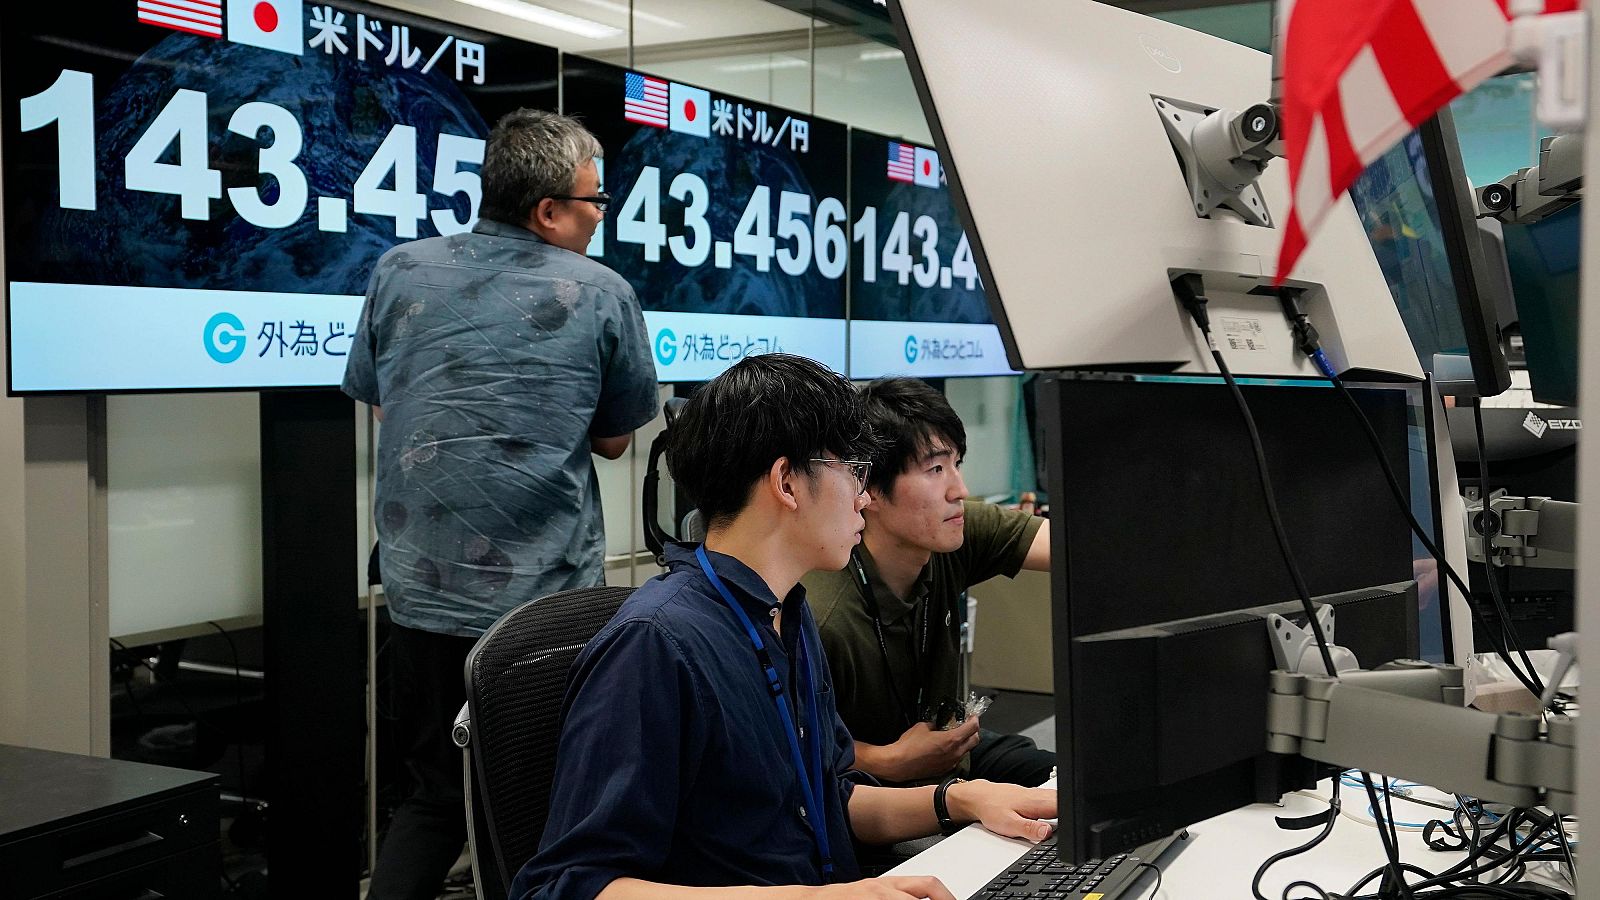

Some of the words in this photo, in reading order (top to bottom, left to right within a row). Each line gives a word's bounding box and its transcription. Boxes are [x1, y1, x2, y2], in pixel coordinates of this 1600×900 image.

[853, 205, 986, 293] 143.4
[257, 320, 355, 358] 外為ど
[1547, 419, 1583, 430] EIZO
